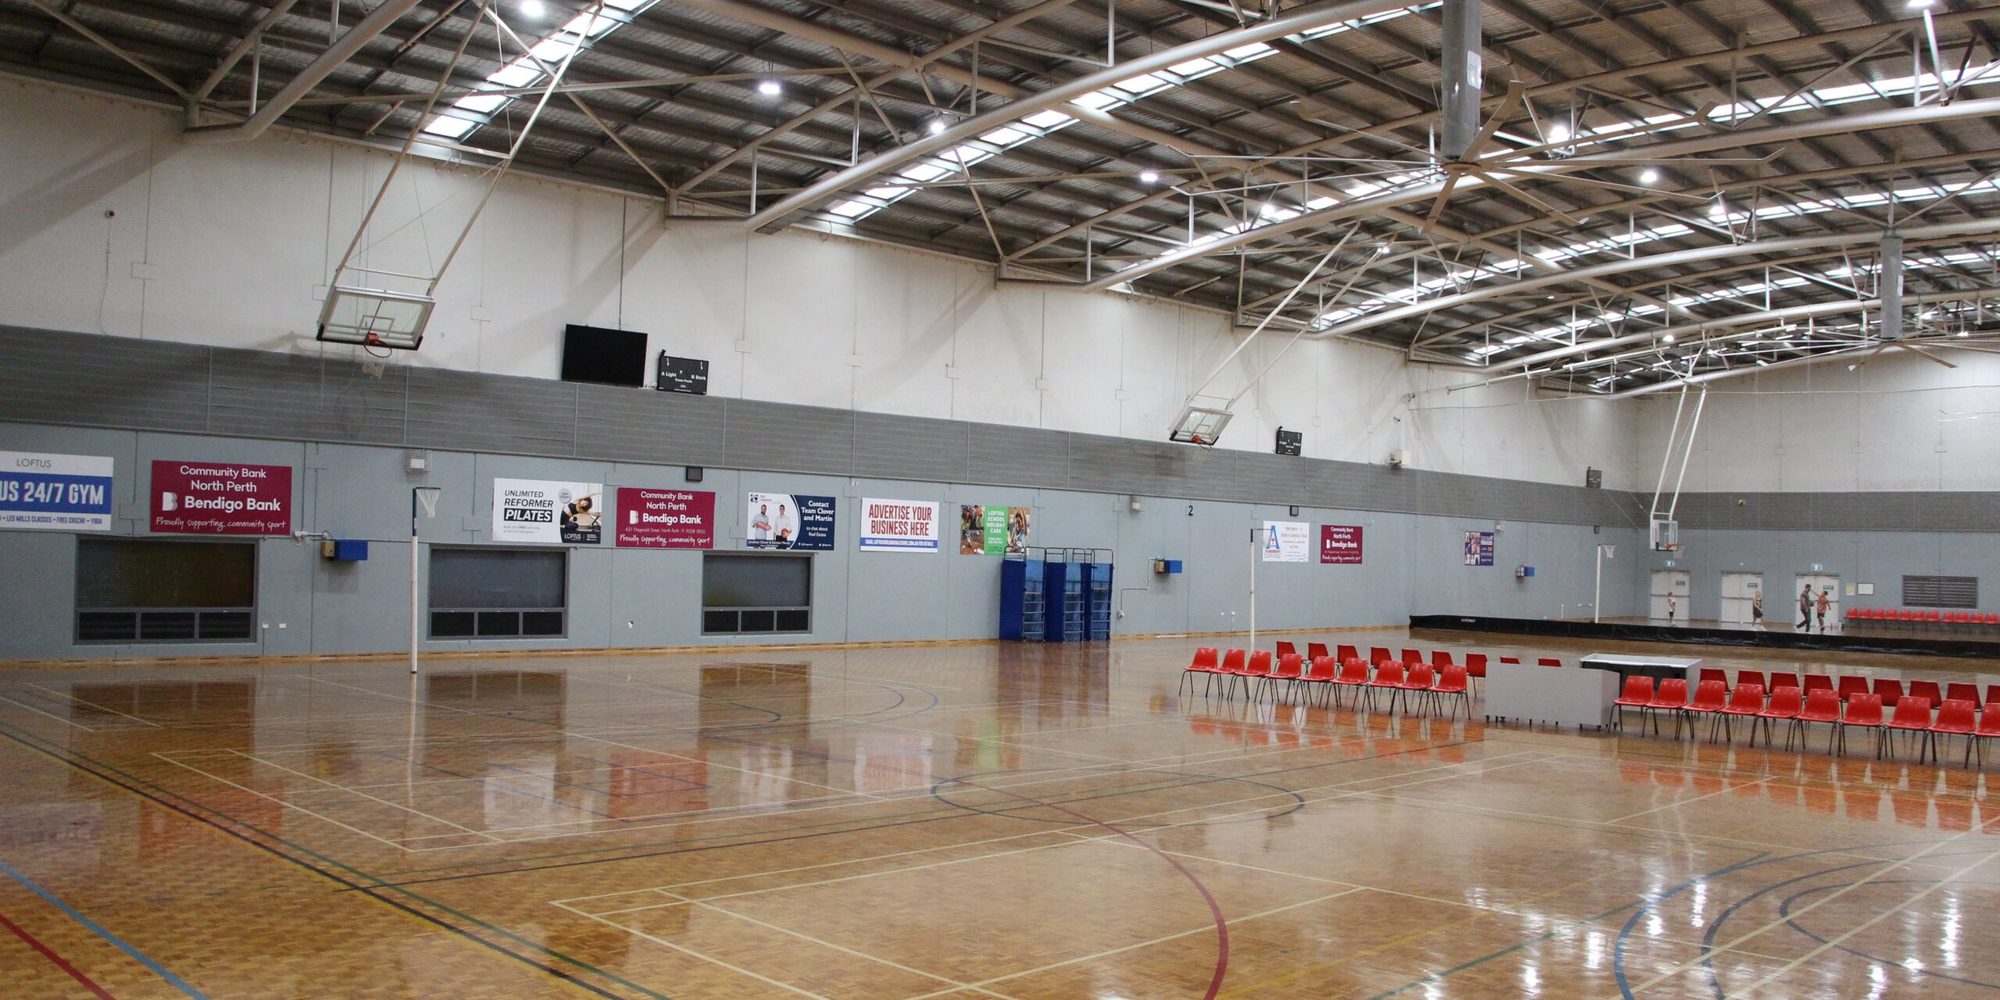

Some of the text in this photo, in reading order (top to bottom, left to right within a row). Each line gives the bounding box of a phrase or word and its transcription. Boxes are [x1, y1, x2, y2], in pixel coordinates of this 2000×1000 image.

[16, 458, 52, 469] LOFTUS
[180, 465, 267, 480] Community Bank
[191, 480, 257, 493] North Perth
[23, 481, 64, 503] 24/7
[68, 483, 104, 505] GYM
[504, 489, 544, 498] UNLIMITED
[640, 491, 693, 502] Community Bank
[184, 495, 281, 514] Bendigo Bank
[504, 498, 554, 508] REFORMER
[646, 502, 687, 511] North Perth
[808, 500, 830, 508] Contact
[505, 509, 552, 522] PILATES
[801, 506, 835, 515] Team Clover
[868, 503, 933, 521] ADVERTISE YOUR
[1188, 505, 1194, 517] 2
[156, 516, 286, 532] Proudly supporting community sport
[642, 512, 702, 526] Bendigo Bank
[815, 514, 833, 522] Martin
[870, 520, 930, 536] BUSINESS HERE
[668, 536, 696, 547] community
